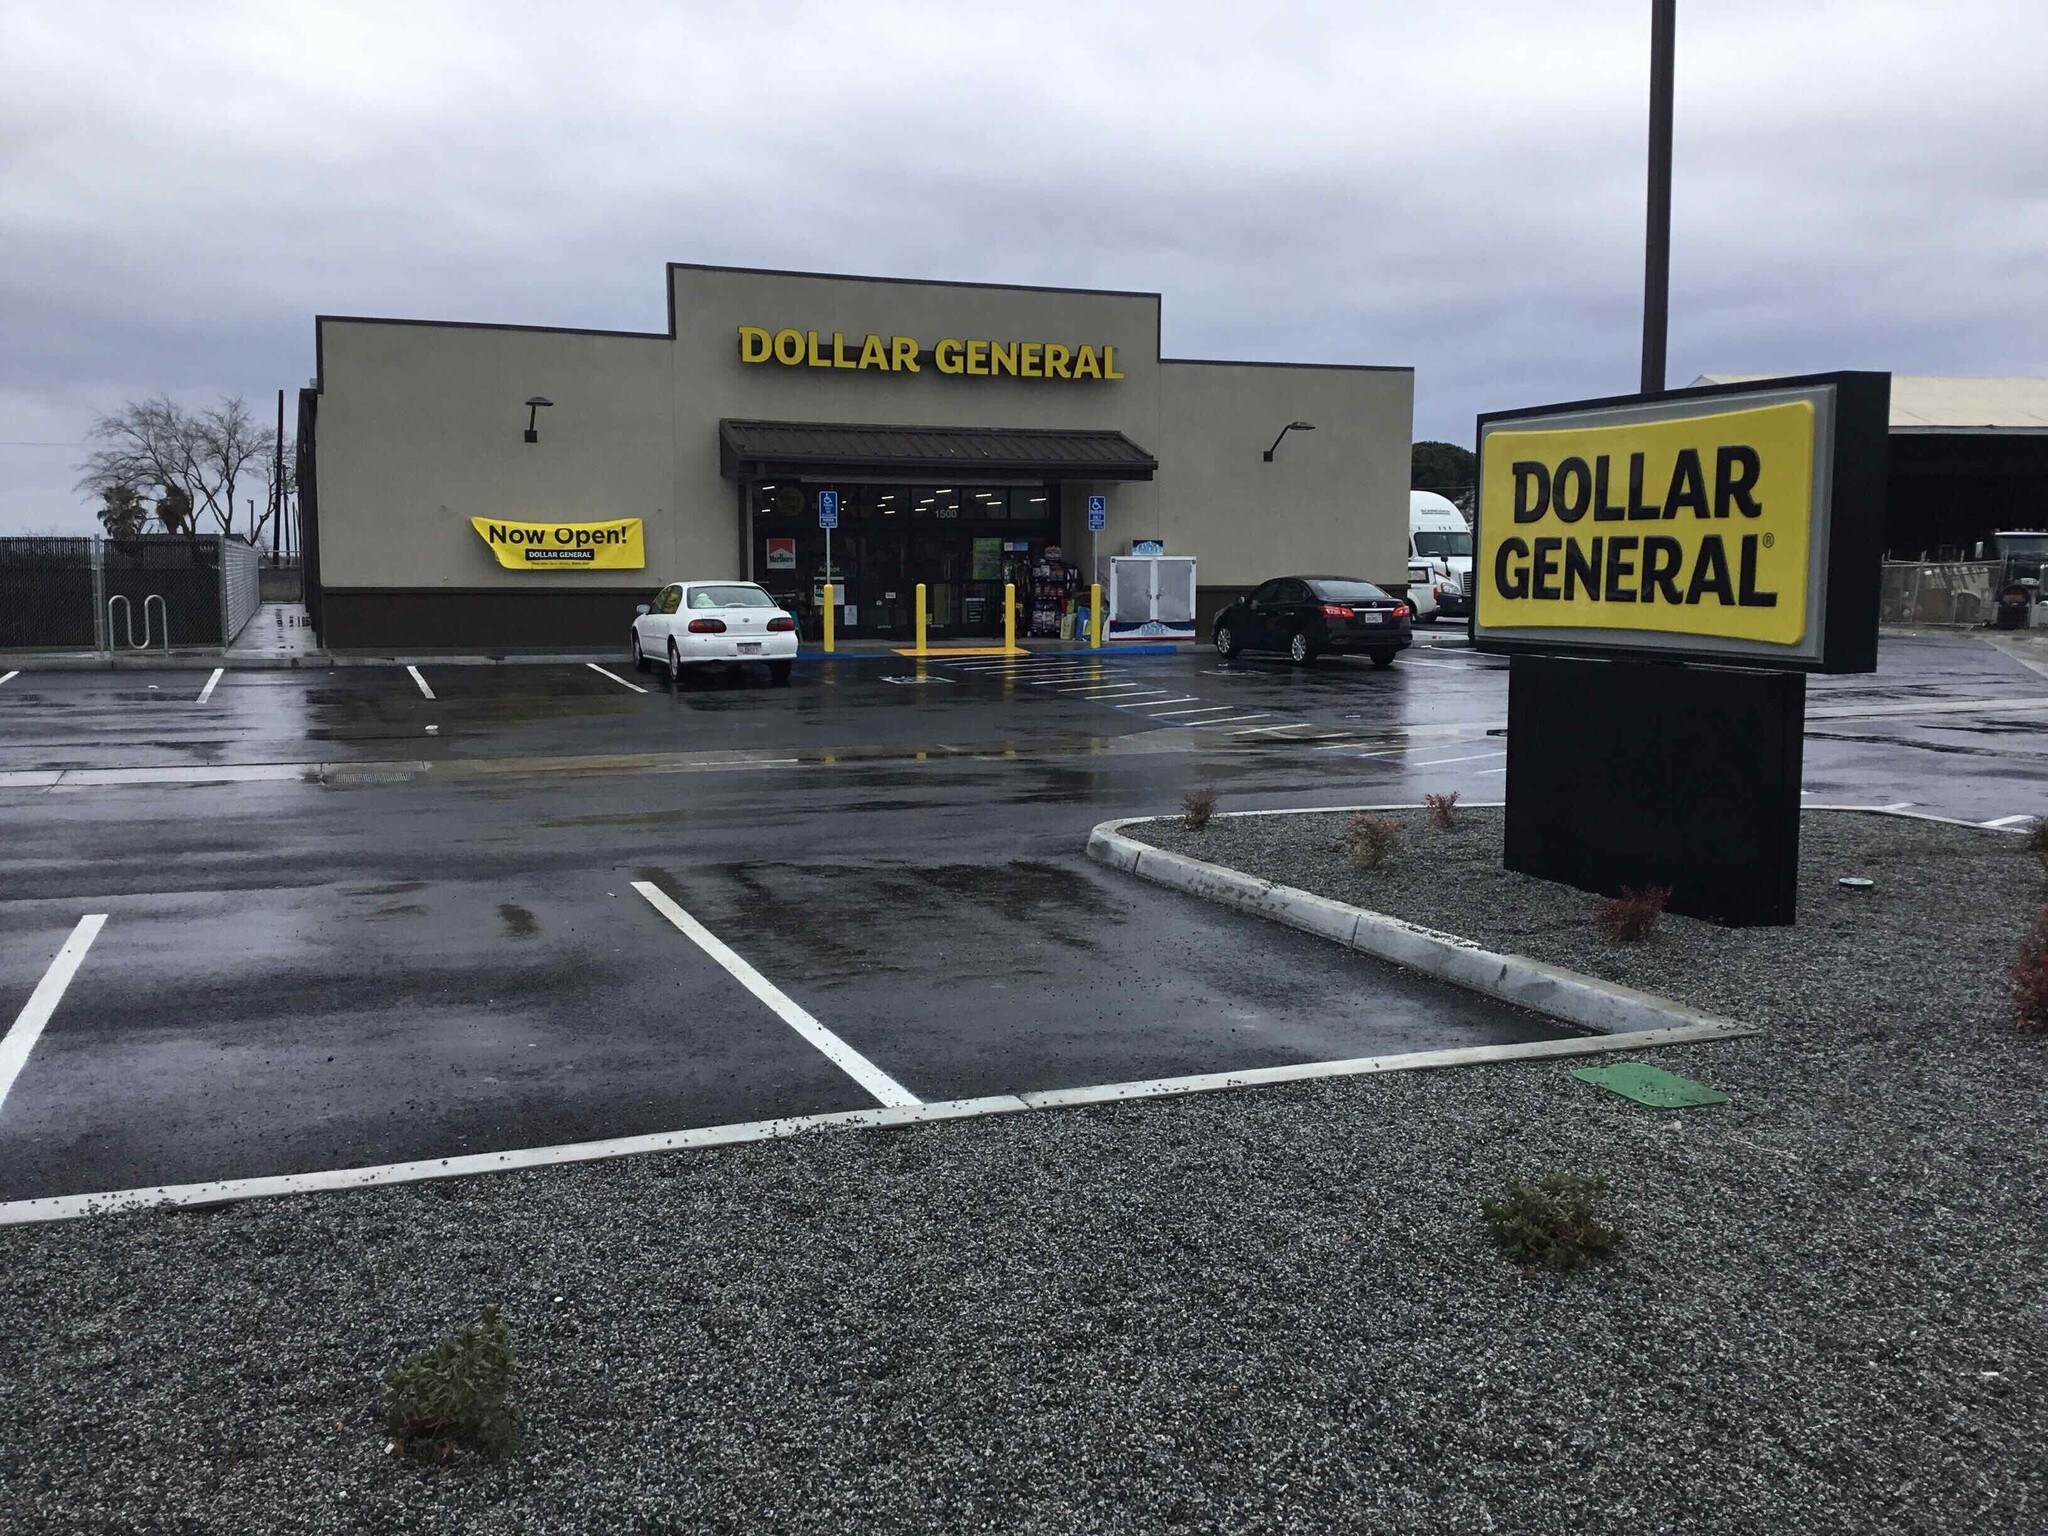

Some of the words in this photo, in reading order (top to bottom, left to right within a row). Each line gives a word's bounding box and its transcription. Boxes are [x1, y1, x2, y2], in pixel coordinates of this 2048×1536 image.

[738, 325, 921, 373] DOLLAR
[935, 338, 1126, 380] GENERAL
[1512, 444, 1763, 524] DOLLAR
[935, 509, 957, 519] 1500
[488, 525, 546, 545] Now
[554, 526, 628, 548] Open!
[528, 551, 559, 559] DOLLAR
[559, 551, 592, 559] GENERAL
